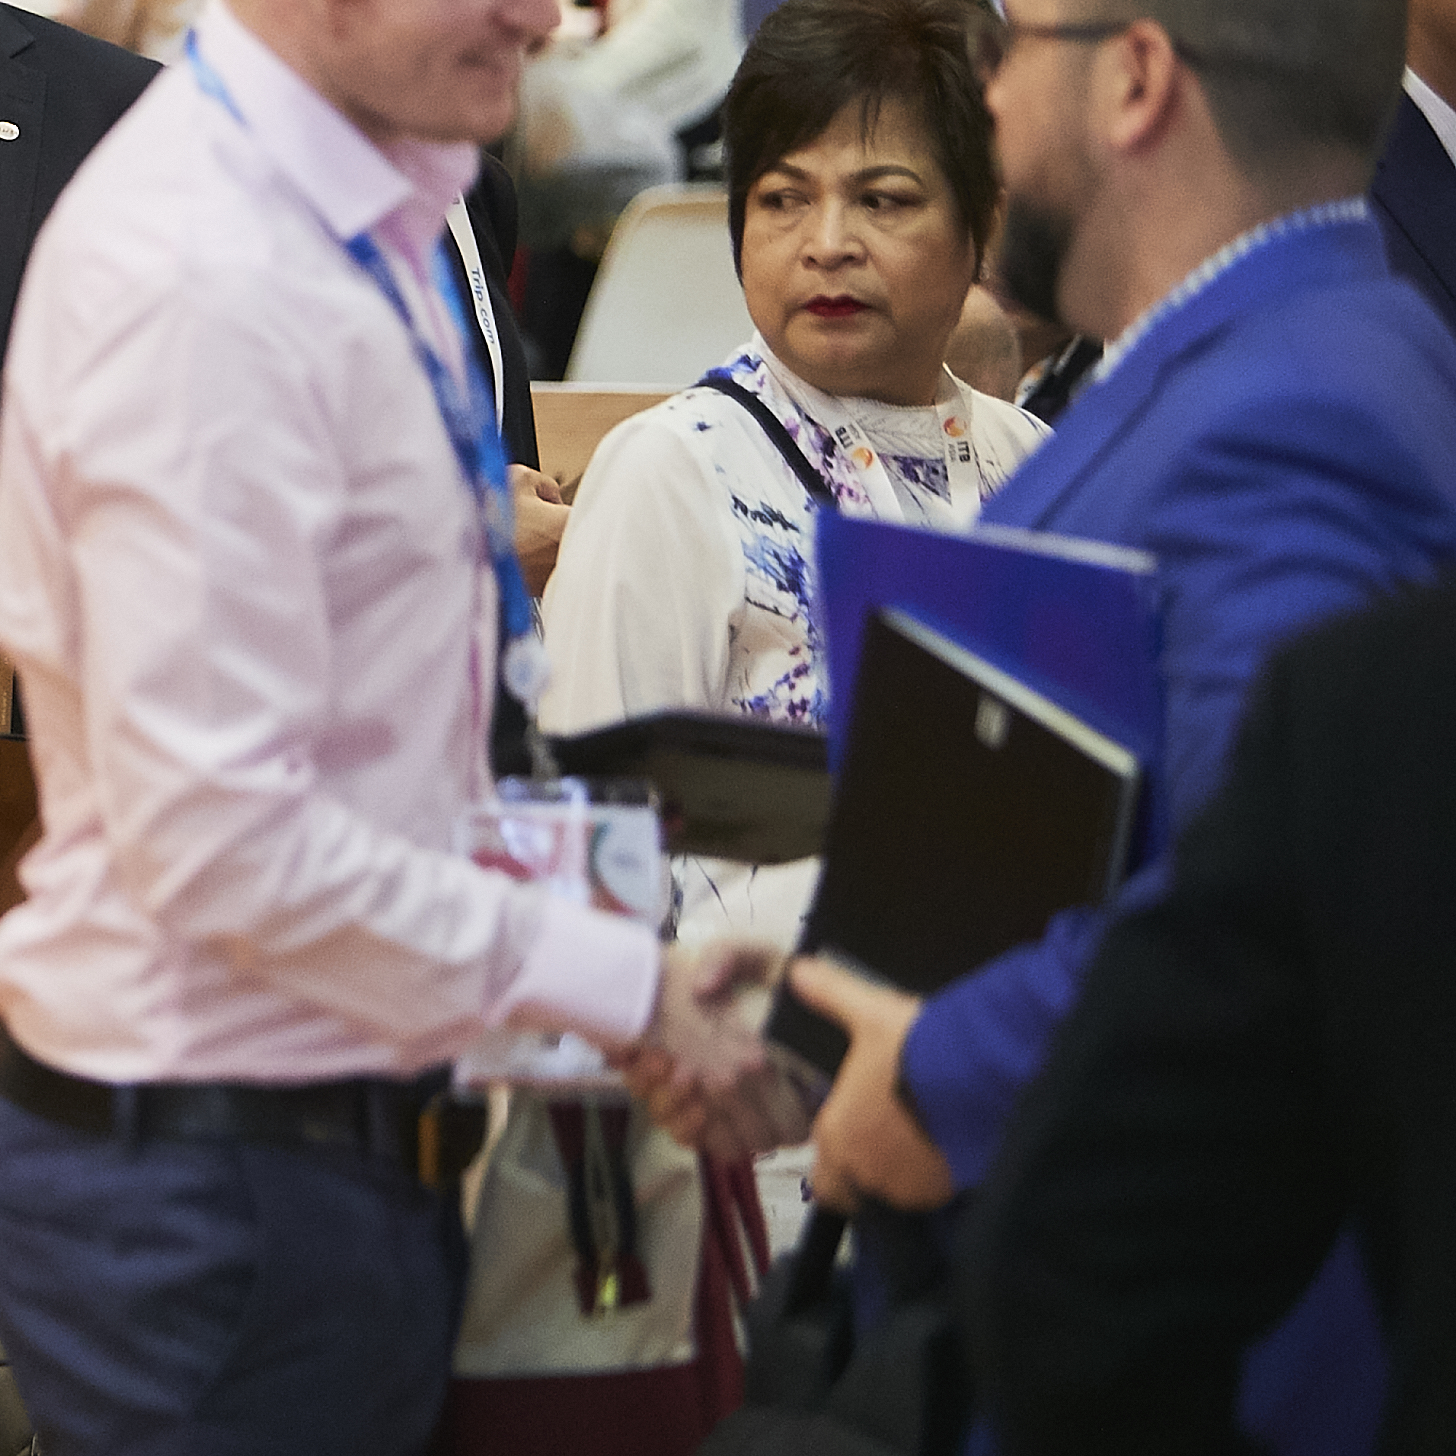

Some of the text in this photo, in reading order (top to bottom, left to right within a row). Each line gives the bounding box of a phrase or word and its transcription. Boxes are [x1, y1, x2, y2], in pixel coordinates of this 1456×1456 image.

[470, 267, 496, 345] Trip.com
[835, 426, 854, 449] ITB
[957, 441, 971, 463] ITB
